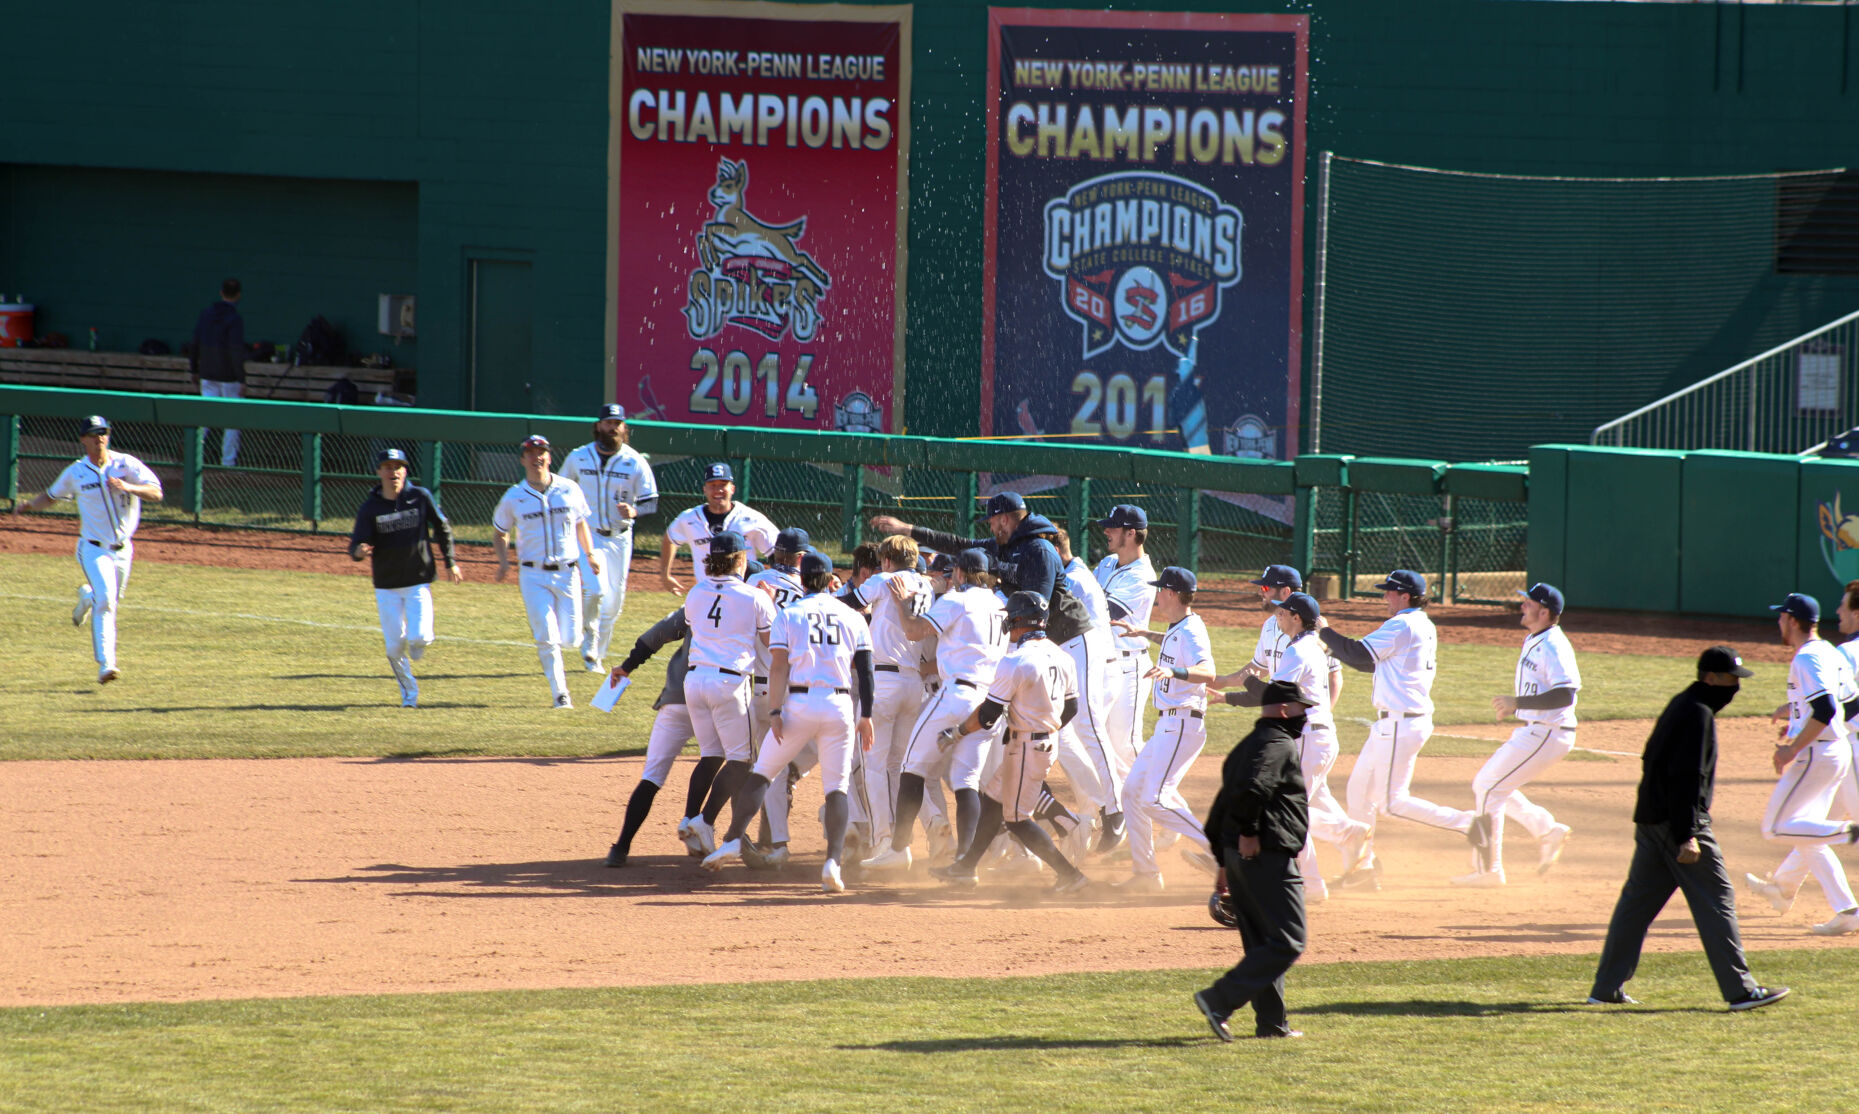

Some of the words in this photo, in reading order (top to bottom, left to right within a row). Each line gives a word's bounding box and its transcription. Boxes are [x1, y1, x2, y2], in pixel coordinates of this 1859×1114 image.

[637, 47, 682, 73] NEW
[686, 49, 801, 79] YORK-PENN
[807, 55, 885, 80] LEAGUE
[1015, 59, 1063, 87] NEW
[1067, 61, 1190, 90] YORK-PENN
[1196, 65, 1281, 93] LEAGUE
[628, 88, 892, 151] CHAMPIONS
[1007, 102, 1287, 166] CHAMPIONS
[1074, 187, 1098, 208] NEW
[1171, 185, 1212, 214] LEAGUE
[1050, 199, 1236, 277] CHAMPIONS
[1073, 251, 1107, 274] STATE
[1112, 248, 1163, 263] COLLEGE
[1075, 287, 1105, 319] 20
[1179, 293, 1206, 322] 16
[690, 348, 818, 420] 2014
[1070, 370, 1201, 445] 201
[707, 594, 722, 629] 4
[807, 612, 841, 646] 35
[1524, 682, 1538, 697] 29
